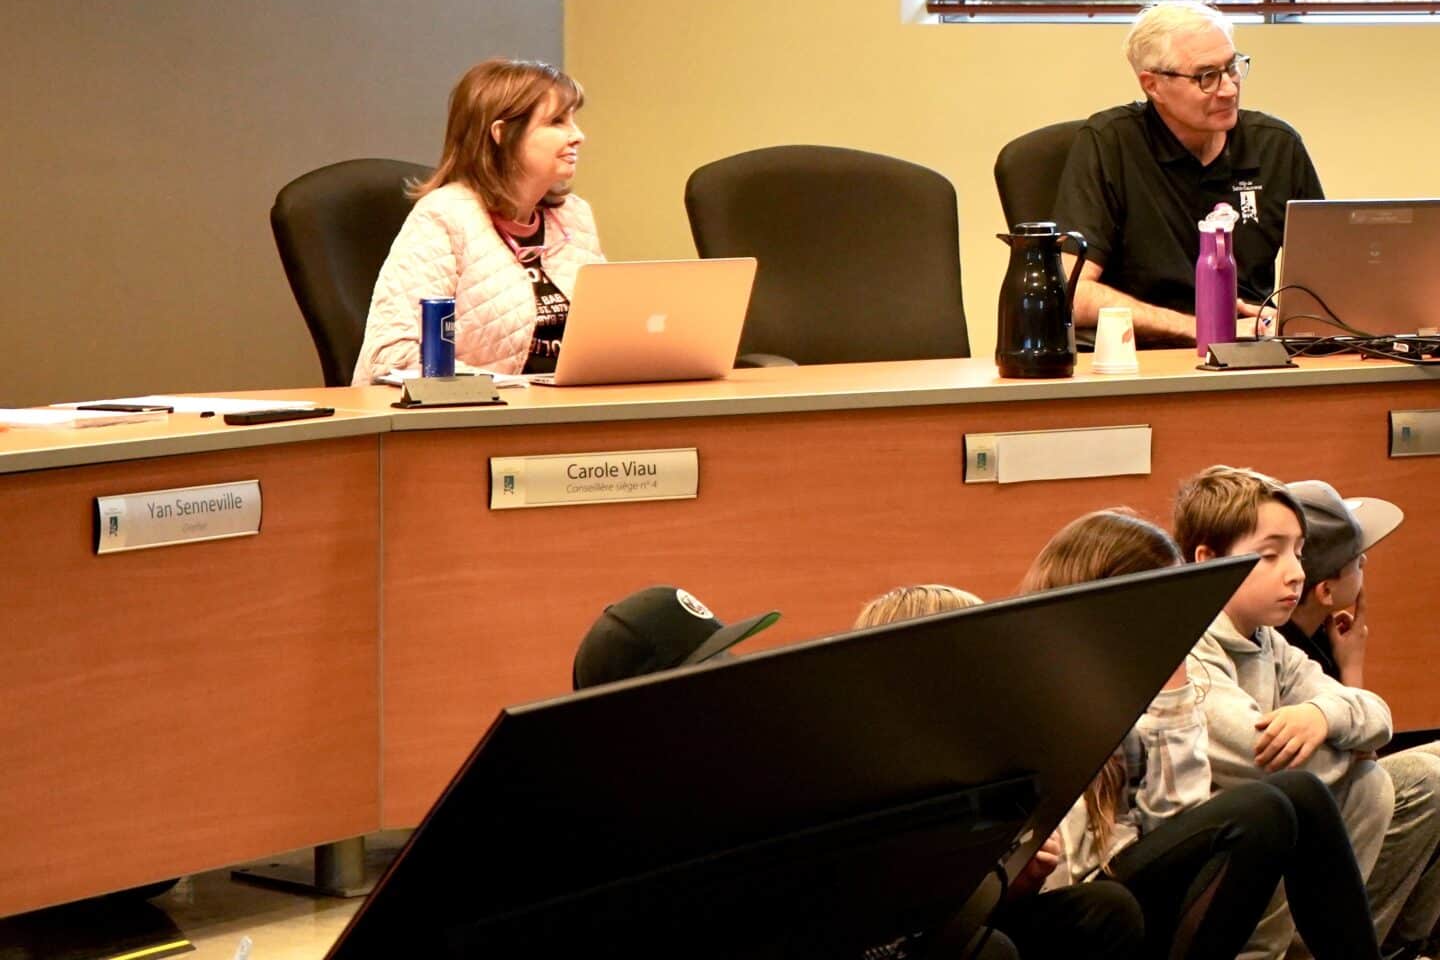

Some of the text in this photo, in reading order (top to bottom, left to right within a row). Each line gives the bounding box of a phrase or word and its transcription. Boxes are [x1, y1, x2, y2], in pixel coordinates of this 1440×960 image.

[566, 460, 657, 480] Carole Viau
[147, 492, 243, 519] Yan Senneville
